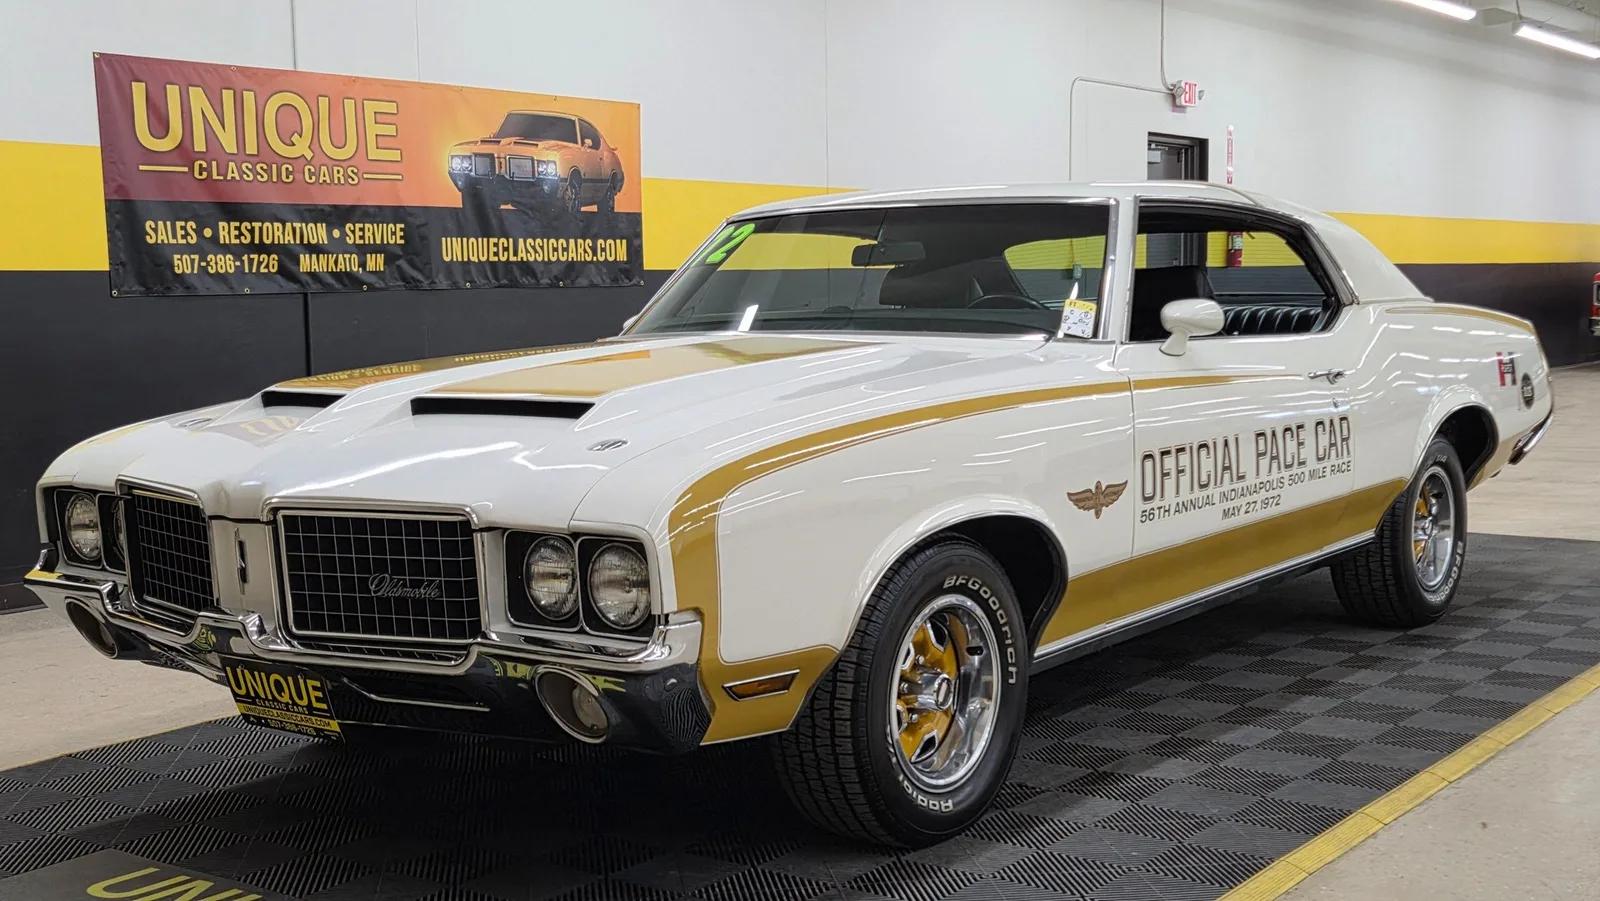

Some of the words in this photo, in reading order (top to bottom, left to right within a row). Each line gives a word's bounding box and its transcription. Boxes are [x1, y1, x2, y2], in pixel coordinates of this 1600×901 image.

[1184, 82, 1197, 104] EXIT
[131, 81, 402, 161] UNIQUE
[193, 161, 294, 183] CLASSIC
[304, 165, 359, 185] CARS
[145, 221, 197, 244] SALES
[218, 221, 328, 244] RESTORATION
[345, 223, 405, 245] SERVICE
[441, 237, 628, 263] UNIQUECLASSICCARS.COM
[173, 254, 279, 274] 507-386-1726
[300, 254, 362, 274] MANKATO,
[366, 254, 385, 272] MN
[1140, 433, 1247, 505] OFFICIAL
[1254, 422, 1308, 479] PACE
[1315, 414, 1352, 464] CAR
[1140, 504, 1171, 524] 56TH
[1173, 494, 1216, 516] ANNUAL
[1219, 476, 1285, 504] INDIANAPOLIS
[1287, 472, 1306, 486] 500
[1307, 466, 1328, 480] MILE
[1329, 460, 1352, 477] RACE
[1221, 503, 1244, 520] MAY
[368, 573, 441, 600] Oldsmobile
[225, 665, 329, 709] UNIQUE
[255, 698, 287, 711] CLASSIC
[288, 703, 309, 714] CARS
